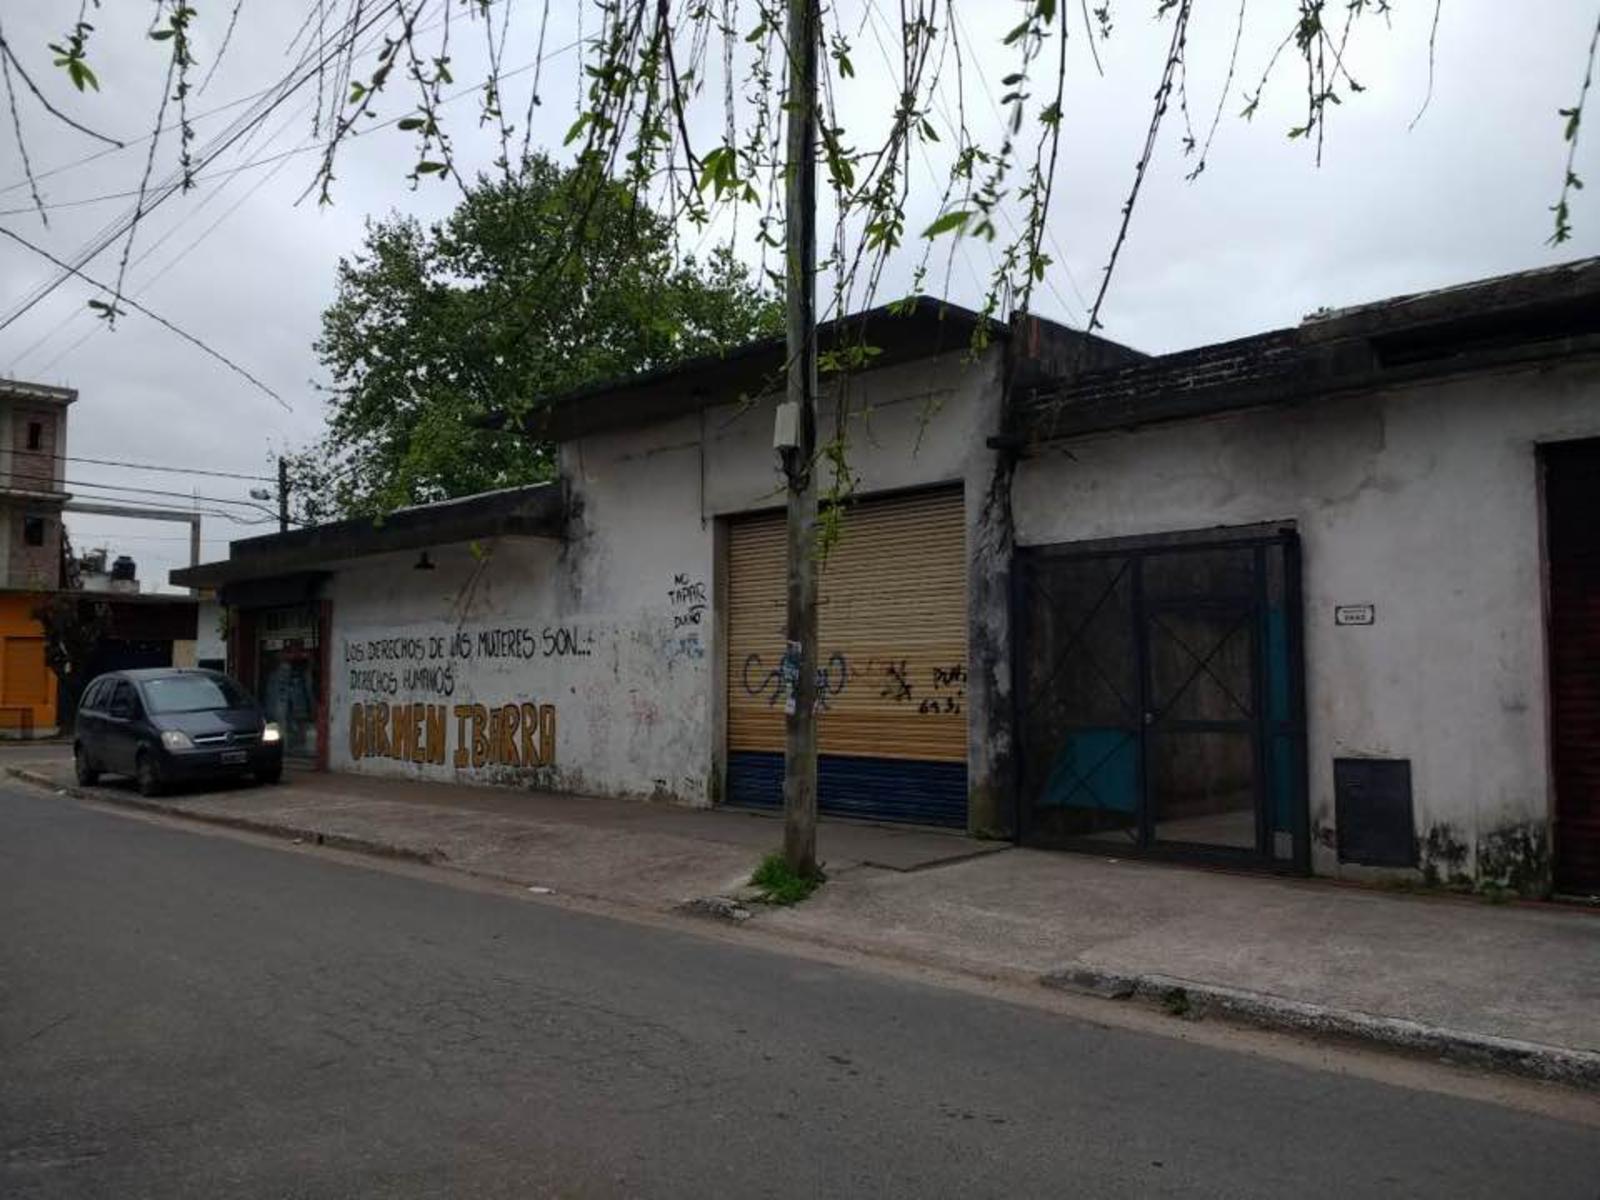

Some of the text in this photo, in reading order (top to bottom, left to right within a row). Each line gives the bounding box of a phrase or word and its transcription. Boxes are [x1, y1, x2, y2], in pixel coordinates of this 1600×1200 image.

[346, 639, 365, 663] LOS
[368, 638, 425, 661] DERECHOS
[429, 637, 446, 660] DE
[402, 666, 455, 697] HUMANOS
[350, 702, 557, 769] CARMEN IBARRA
